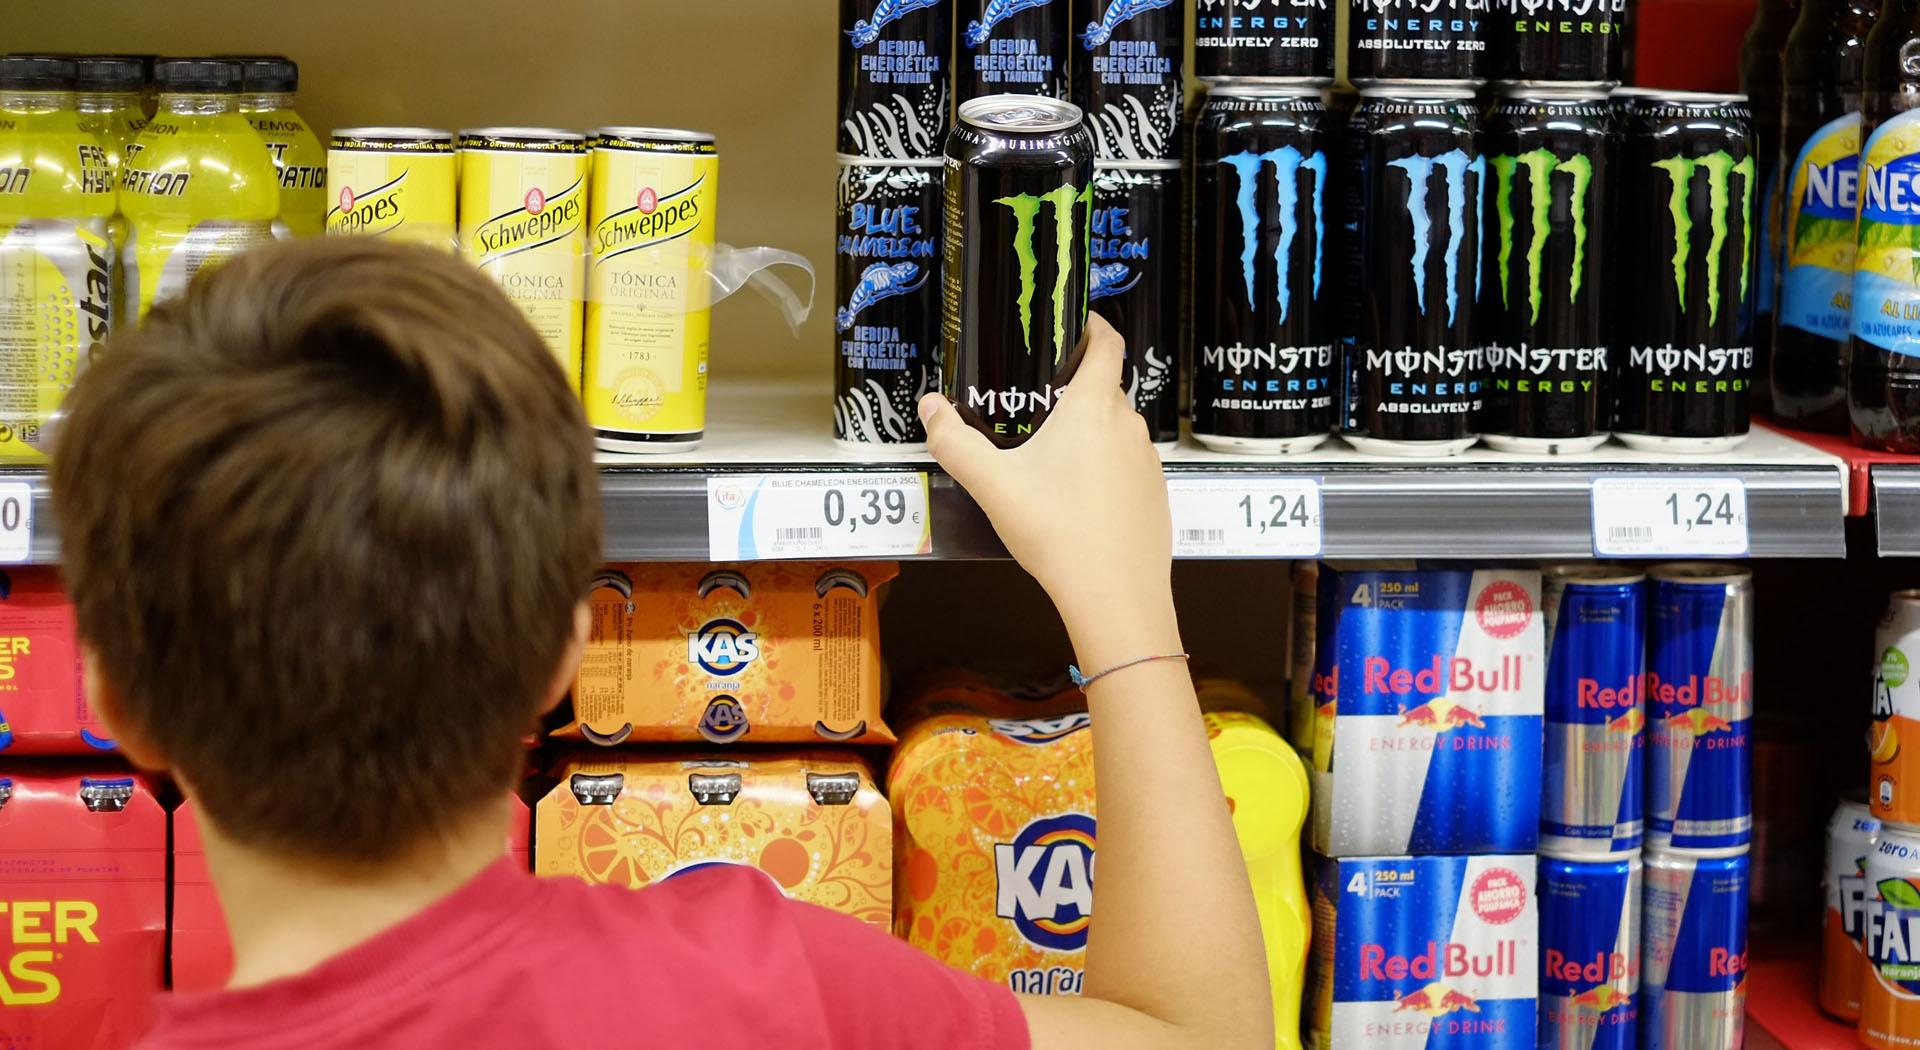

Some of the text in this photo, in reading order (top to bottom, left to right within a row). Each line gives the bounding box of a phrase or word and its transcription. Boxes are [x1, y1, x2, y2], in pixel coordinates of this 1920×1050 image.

[1200, 17, 1308, 29] ENERGY
[1367, 19, 1480, 32] ENERGY
[1515, 20, 1622, 33] ENERGY
[878, 39, 926, 56] BEBIDA
[989, 38, 1038, 55] BEBIDA
[1109, 40, 1157, 56] BEBIDA
[1196, 36, 1319, 48] BSOLUTELY ZERO
[1358, 39, 1486, 51] ABSOLUTELY ZERO
[860, 54, 940, 72] ENERGÉTICA
[974, 53, 1053, 72] ENERGÉTICA
[1093, 55, 1172, 73] ENERGÉTICA
[869, 71, 931, 84] CON TAURINA
[983, 70, 1043, 83] CON TAURINA
[1101, 72, 1162, 85] CON TAURINA
[1249, 102, 1278, 112] FREE
[1418, 105, 1447, 115] FREE
[1651, 107, 1711, 118] TAURINA
[479, 197, 581, 258] Schweppes
[597, 193, 701, 257] Schweppes
[849, 203, 919, 236] BLUE
[610, 270, 677, 289] TÓNICA
[504, 286, 564, 302] RIGINAL
[609, 285, 677, 300] ORIGINAL
[854, 325, 900, 342] BEBIDA
[628, 351, 651, 361] 1783
[1485, 341, 1608, 375] ONSTER
[1629, 343, 1754, 377] MONSTE
[1223, 378, 1328, 392] ENERGY
[1212, 397, 1308, 411] ABSOLUTELY
[1377, 401, 1471, 414] ABSOLUTELY
[772, 477, 919, 488] BLUE CHAMELEON ENERGETICA 25CL
[823, 488, 906, 533] 0,39
[1238, 494, 1309, 534] 1,24
[1665, 492, 1734, 531] 1,24
[1351, 583, 1372, 608] 4
[1379, 581, 1420, 593] 250 ml
[1379, 600, 1405, 609] PACK
[1483, 600, 1526, 616] AHORRO
[813, 618, 823, 637] 200
[687, 632, 760, 664] KAS
[1363, 654, 1523, 696] Red Bull
[706, 681, 741, 690] naranja
[1577, 674, 1634, 708] Red
[1369, 735, 1512, 752] ENERGY DRINK
[1879, 841, 1908, 858] zero
[994, 842, 1097, 921] KA
[1375, 869, 1415, 882] 250 ml
[1347, 872, 1368, 897] 4
[1375, 888, 1401, 898] PACK
[1478, 886, 1520, 902] AHORRO
[1359, 940, 1516, 982] Red Bull
[1545, 947, 1604, 983] Red
[1365, 1018, 1506, 1037] ENERGY DRINK
